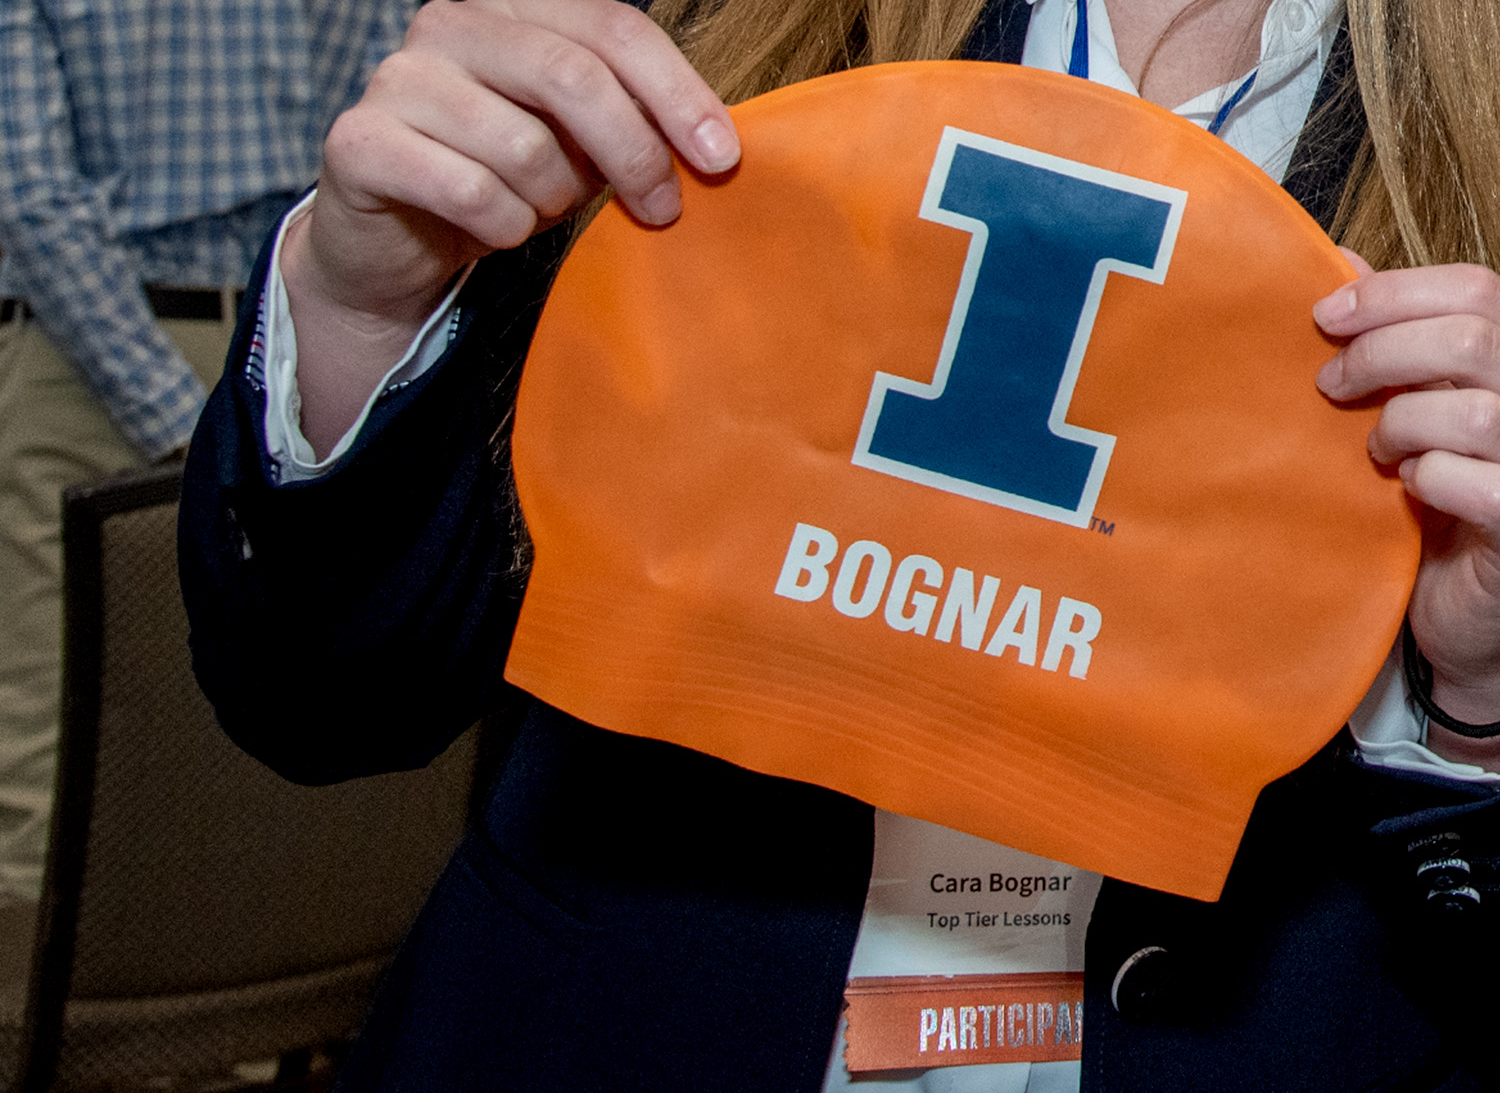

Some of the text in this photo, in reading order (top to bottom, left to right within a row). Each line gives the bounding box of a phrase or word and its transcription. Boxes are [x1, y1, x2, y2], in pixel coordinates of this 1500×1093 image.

[774, 522, 1104, 681] BOGNAR
[929, 872, 1073, 898] Cara Bognar
[927, 910, 1072, 931] Top Tier Lessons
